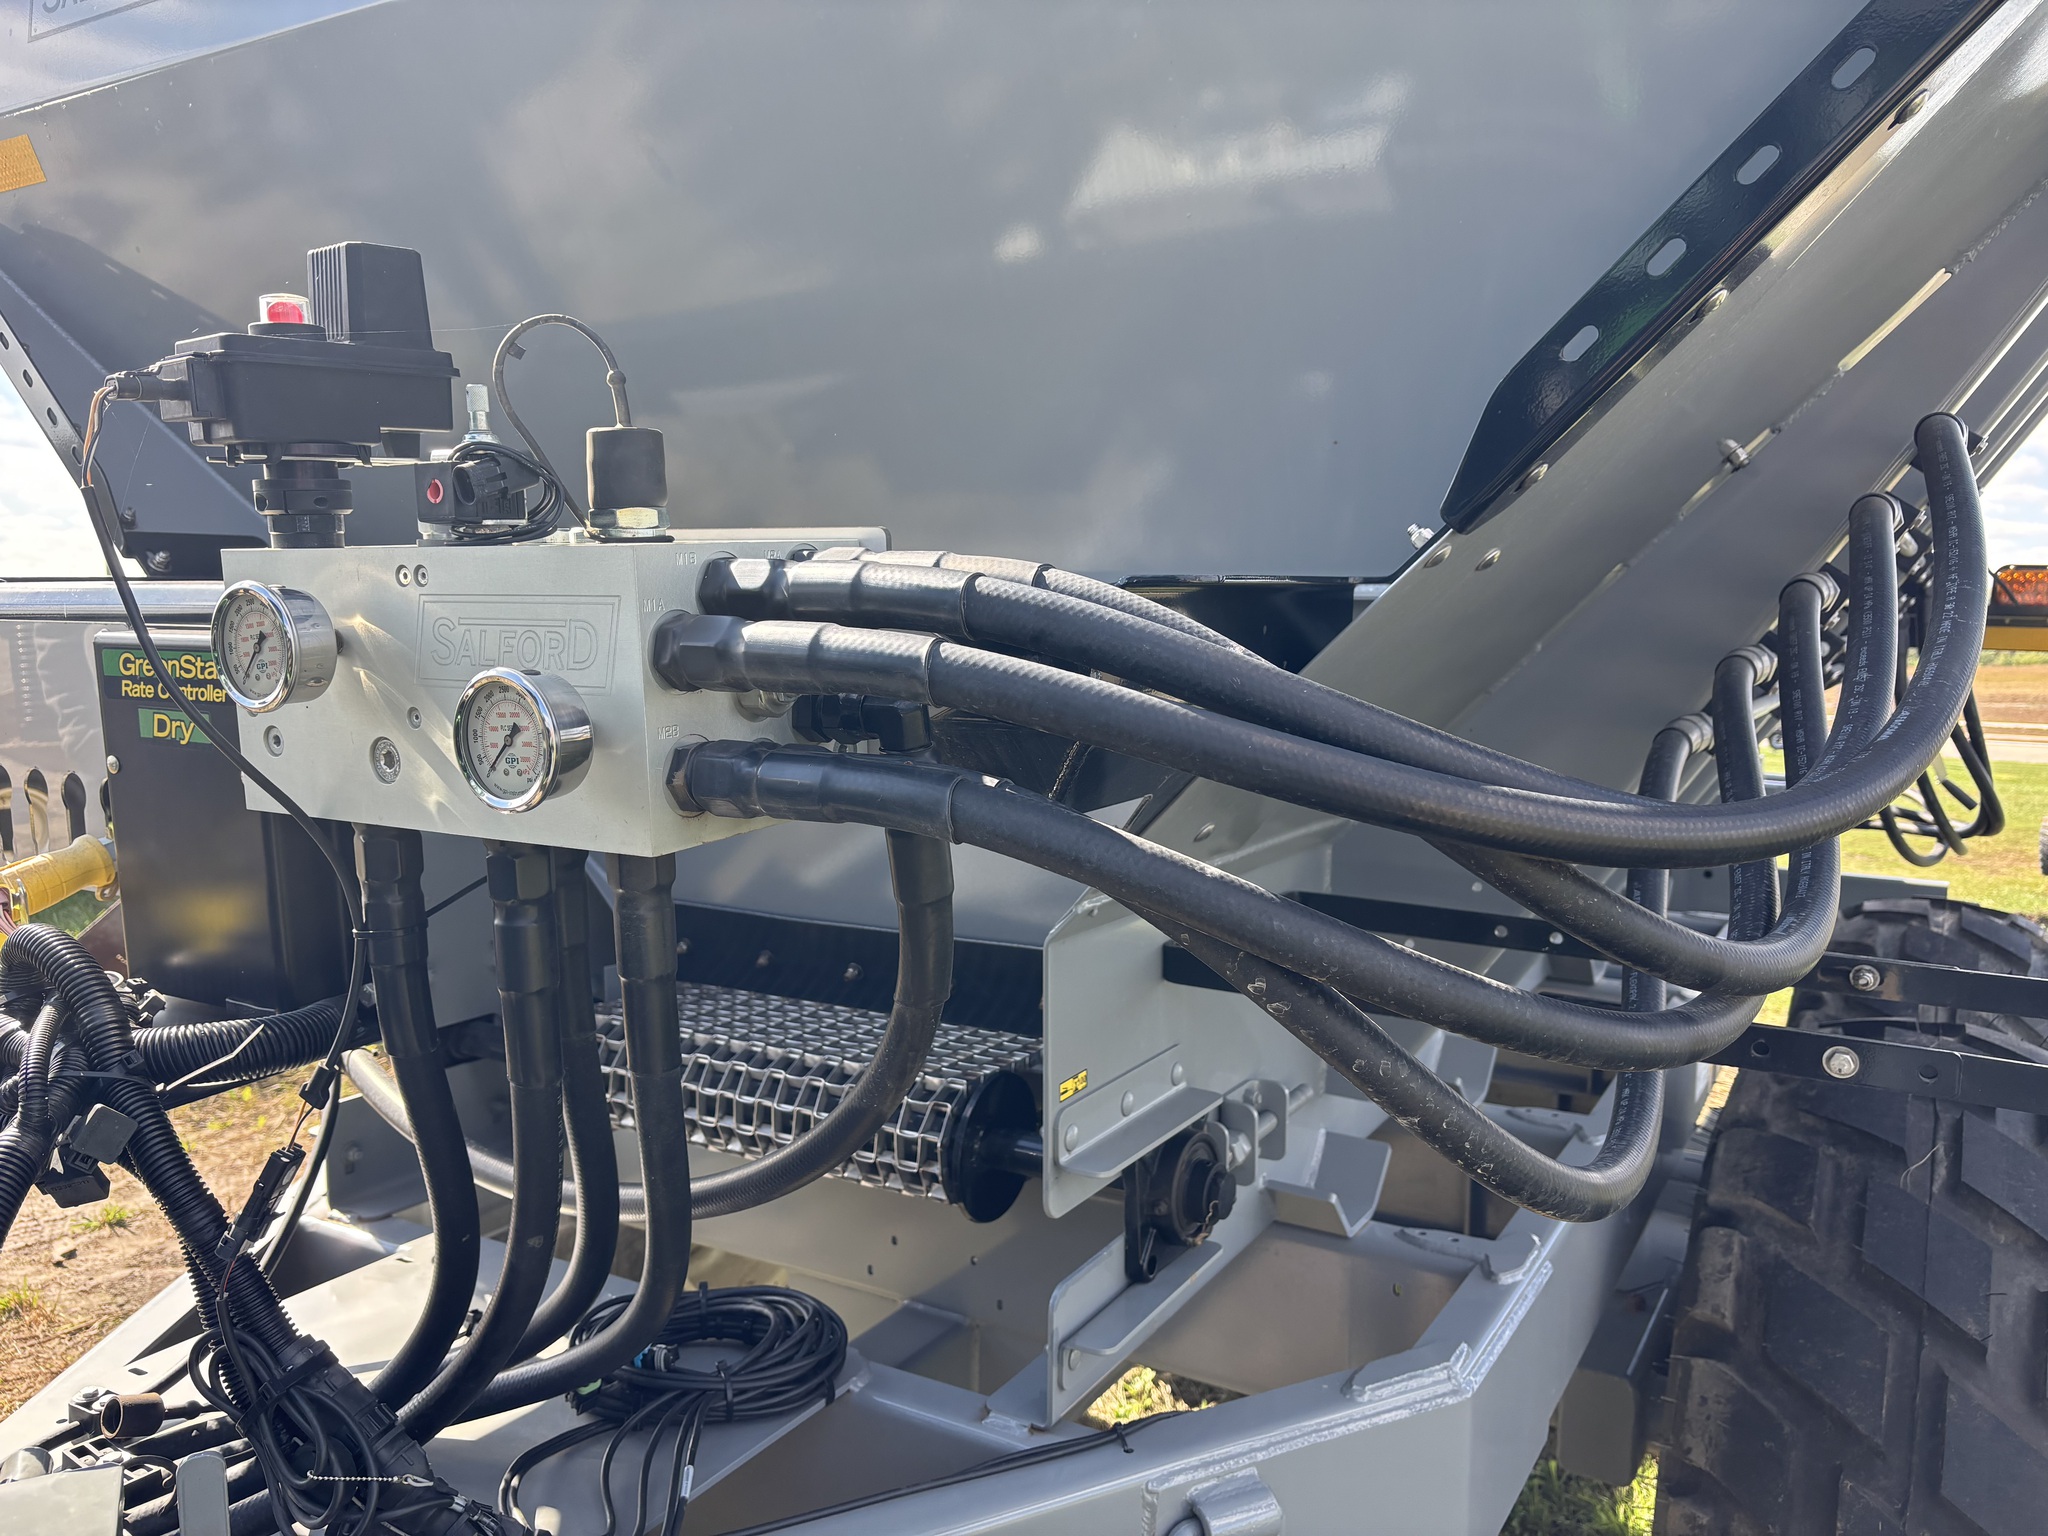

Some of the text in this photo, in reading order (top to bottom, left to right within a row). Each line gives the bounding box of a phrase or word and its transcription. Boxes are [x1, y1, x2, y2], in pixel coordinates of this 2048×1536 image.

[431, 616, 599, 671] SALFORD
[119, 651, 219, 680] GrenSta
[121, 680, 155, 699] Rate
[158, 681, 227, 703] Cntroller
[474, 705, 483, 720] 1500
[498, 685, 510, 694] 2500
[153, 712, 195, 745] Dry
[505, 757, 520, 765] GPI
